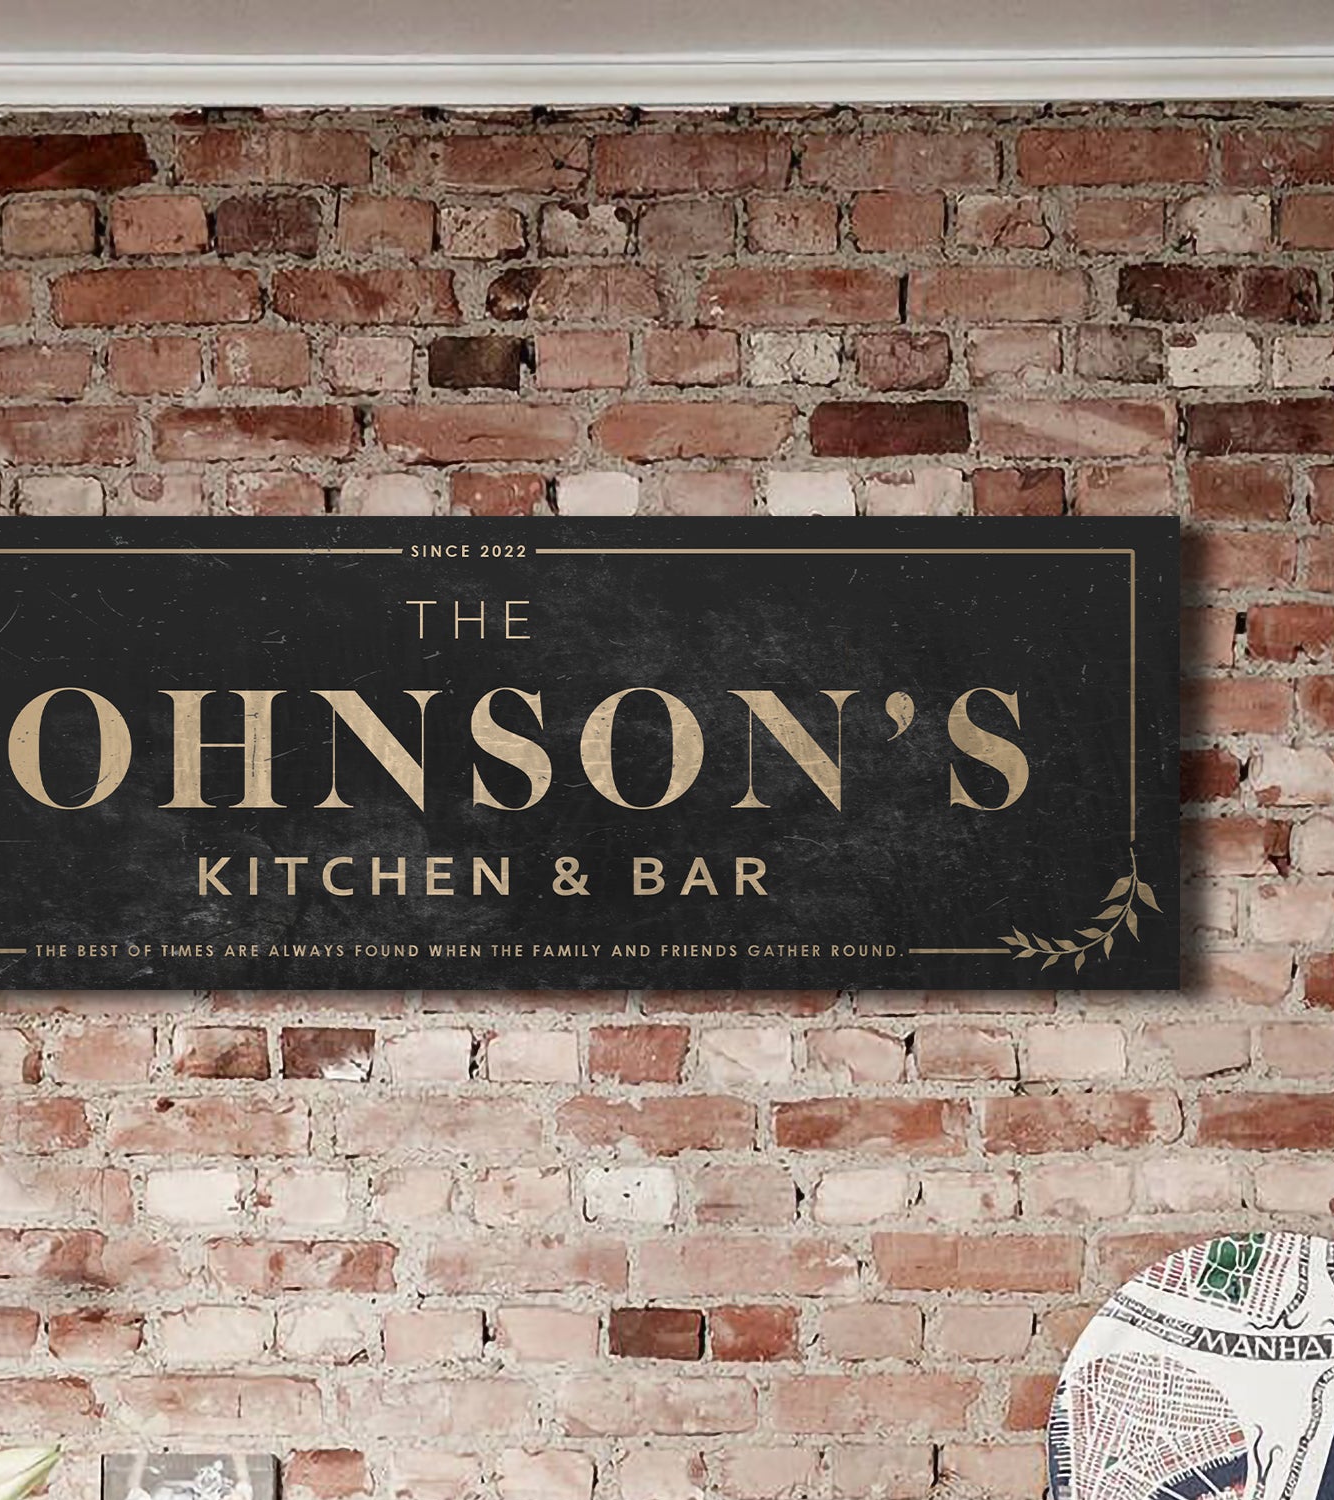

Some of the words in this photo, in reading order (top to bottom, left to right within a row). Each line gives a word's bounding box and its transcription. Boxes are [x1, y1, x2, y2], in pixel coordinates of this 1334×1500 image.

[410, 544, 471, 558] SINCE
[480, 544, 527, 558] 2022
[406, 600, 532, 639] THE
[198, 856, 511, 896] KITCHEN
[552, 856, 591, 896] &
[632, 856, 769, 896] BAR
[35, 944, 67, 957] THE
[77, 944, 118, 957] BEST
[128, 944, 152, 957] OF
[161, 944, 214, 957] TIMES
[224, 944, 259, 957] ARE
[269, 944, 345, 957] ALWAYS
[355, 944, 419, 957] FOUND
[428, 944, 481, 957] WHEN
[491, 944, 524, 957] THE
[532, 944, 601, 957] FAMILY
[611, 944, 651, 957] AND
[661, 944, 738, 957] FRIENDS
[747, 944, 821, 957] GATHER
[831, 944, 905, 957] ROUND.
